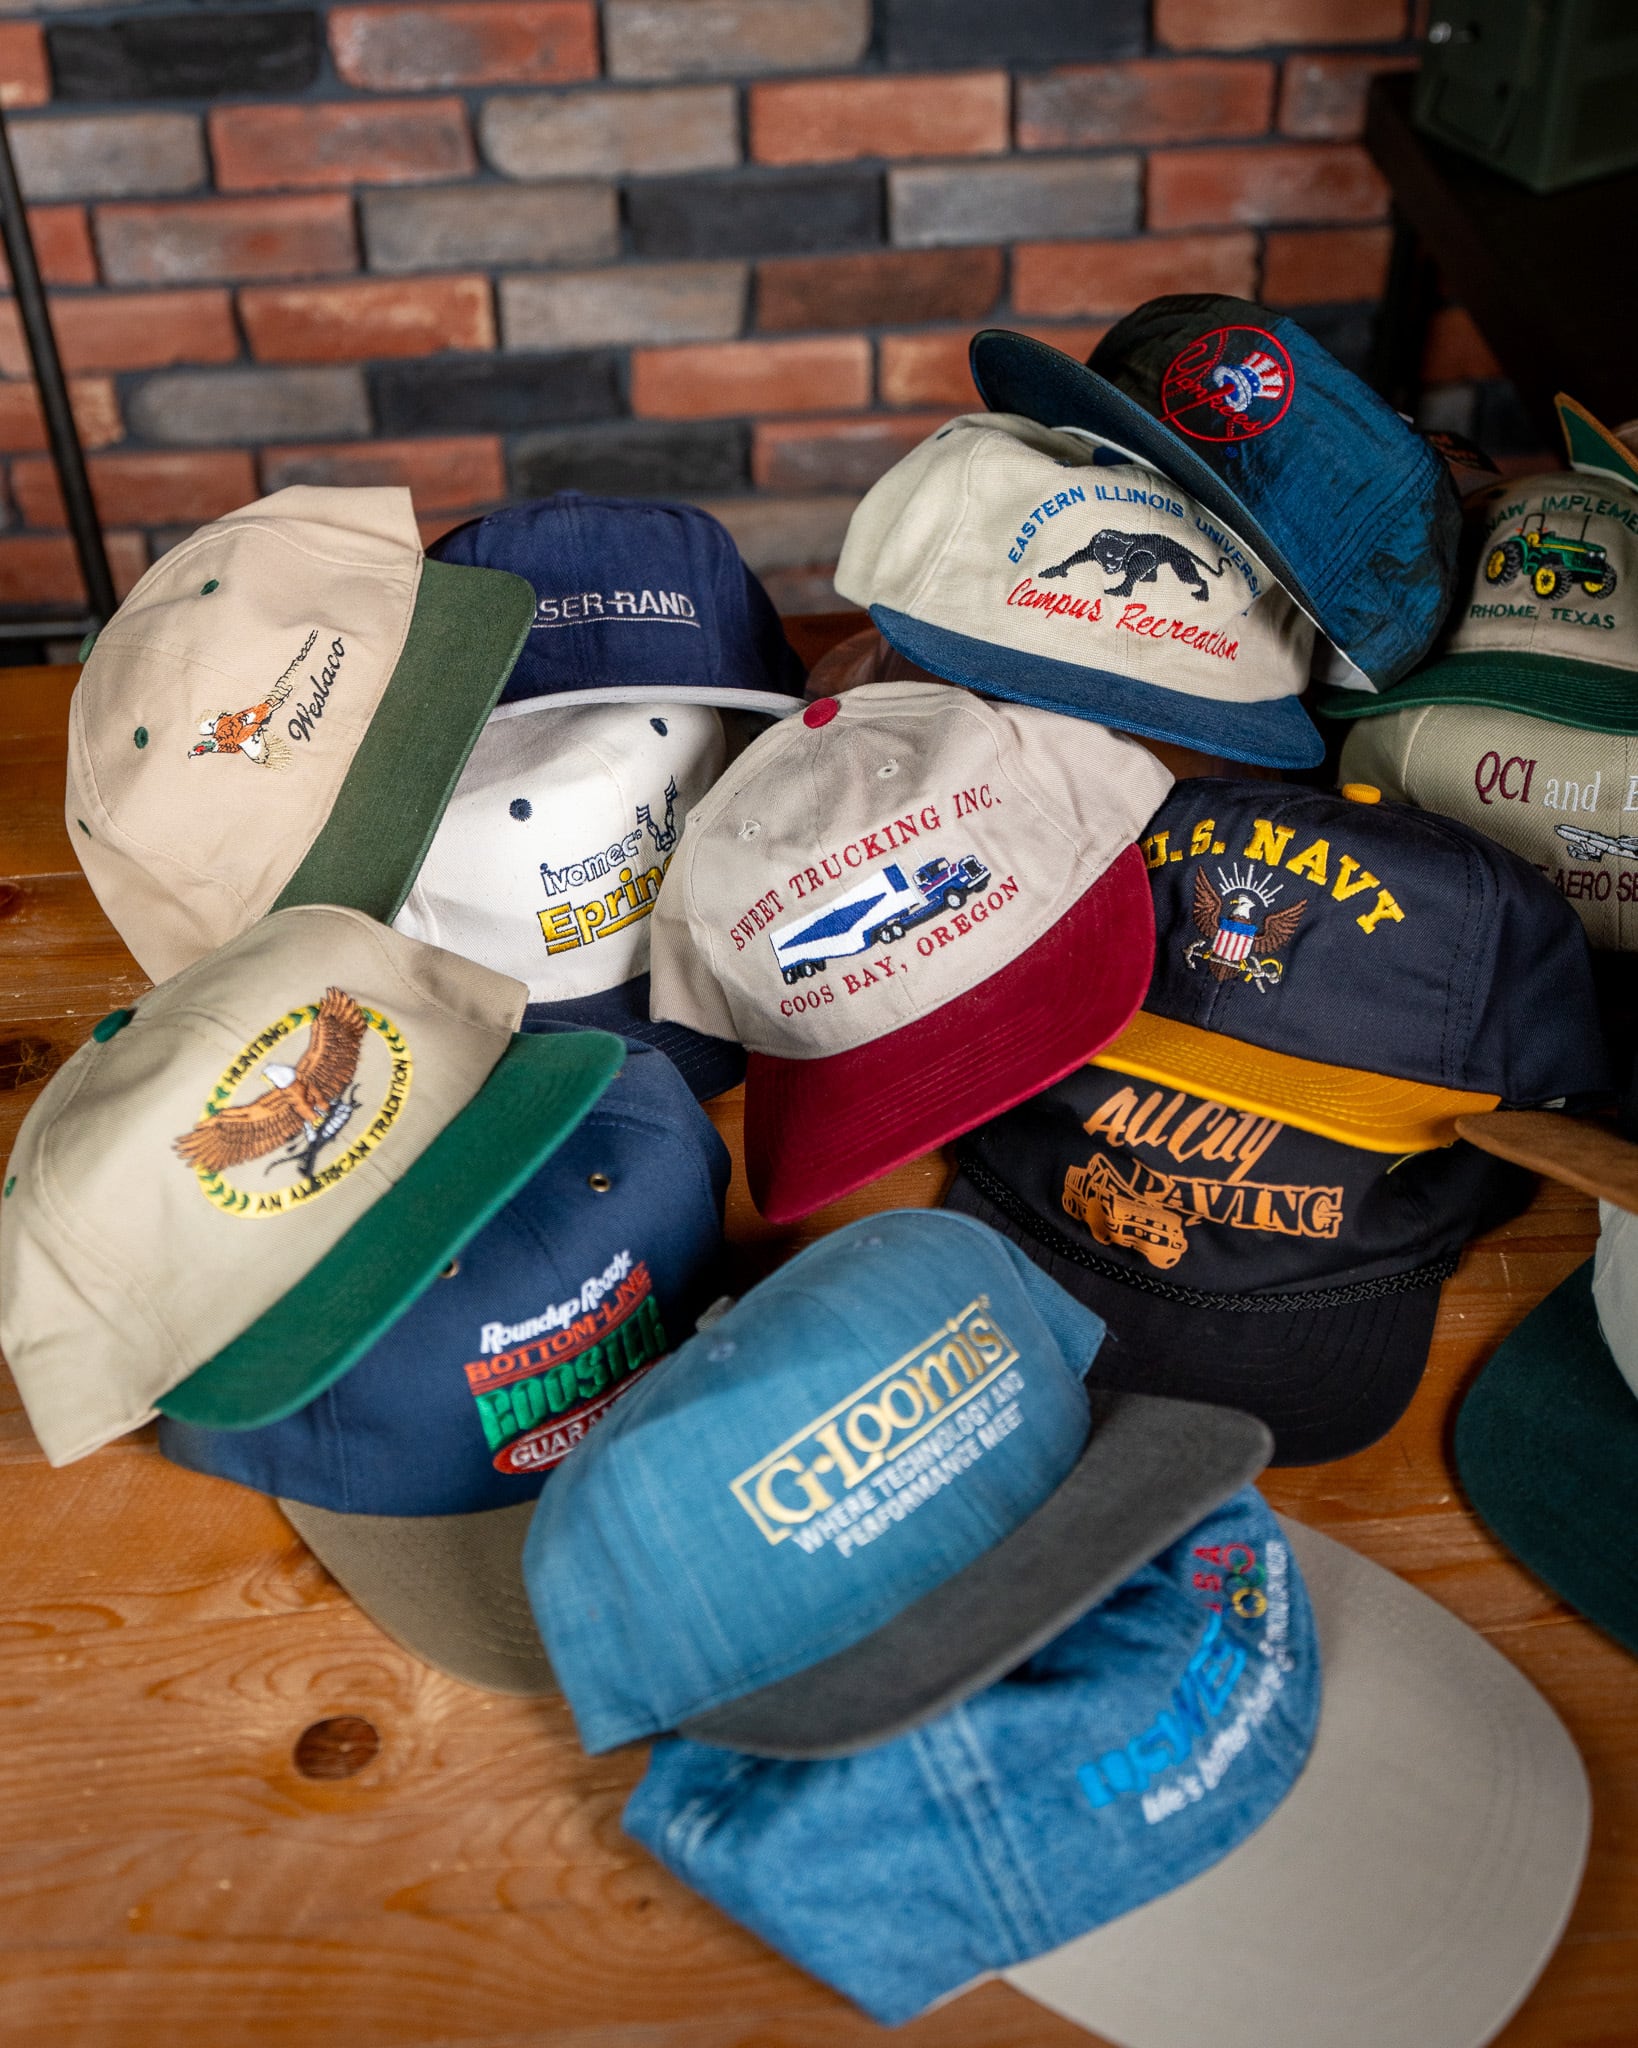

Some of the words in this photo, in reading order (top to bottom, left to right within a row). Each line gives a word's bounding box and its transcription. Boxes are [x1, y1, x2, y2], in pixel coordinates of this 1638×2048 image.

[1008, 485, 1086, 564] EASTERN
[1095, 484, 1185, 519] ILLINOIS
[534, 590, 695, 621] SER-RAND
[1007, 578, 1103, 622] Campus
[1116, 603, 1239, 661] Recreation
[1551, 607, 1616, 629] TEXAS
[288, 637, 345, 742] Weslaco
[1475, 751, 1538, 805] QCI
[1542, 771, 1601, 812] and
[536, 852, 674, 946] Eprin
[729, 890, 785, 951] SWEET
[789, 805, 941, 899] TRUCKING
[953, 784, 1002, 819] INC.
[1140, 818, 1226, 869] U.S.
[1243, 819, 1405, 934] NAVY
[780, 984, 835, 1017] COOS
[842, 956, 908, 995] BAY,
[916, 875, 1020, 957] OREGON
[224, 1022, 289, 1085] HUNTING
[257, 1193, 281, 1211] AN
[369, 1058, 410, 1142] TRADITION
[1083, 1086, 1187, 1147] All
[1131, 1158, 1344, 1239] PAVING
[463, 1260, 650, 1383] BOTTOM-LINE
[480, 1298, 580, 1354] Roundup
[790, 1484, 880, 1554] WHERE
[870, 1397, 995, 1497] TECHNOLOGY
